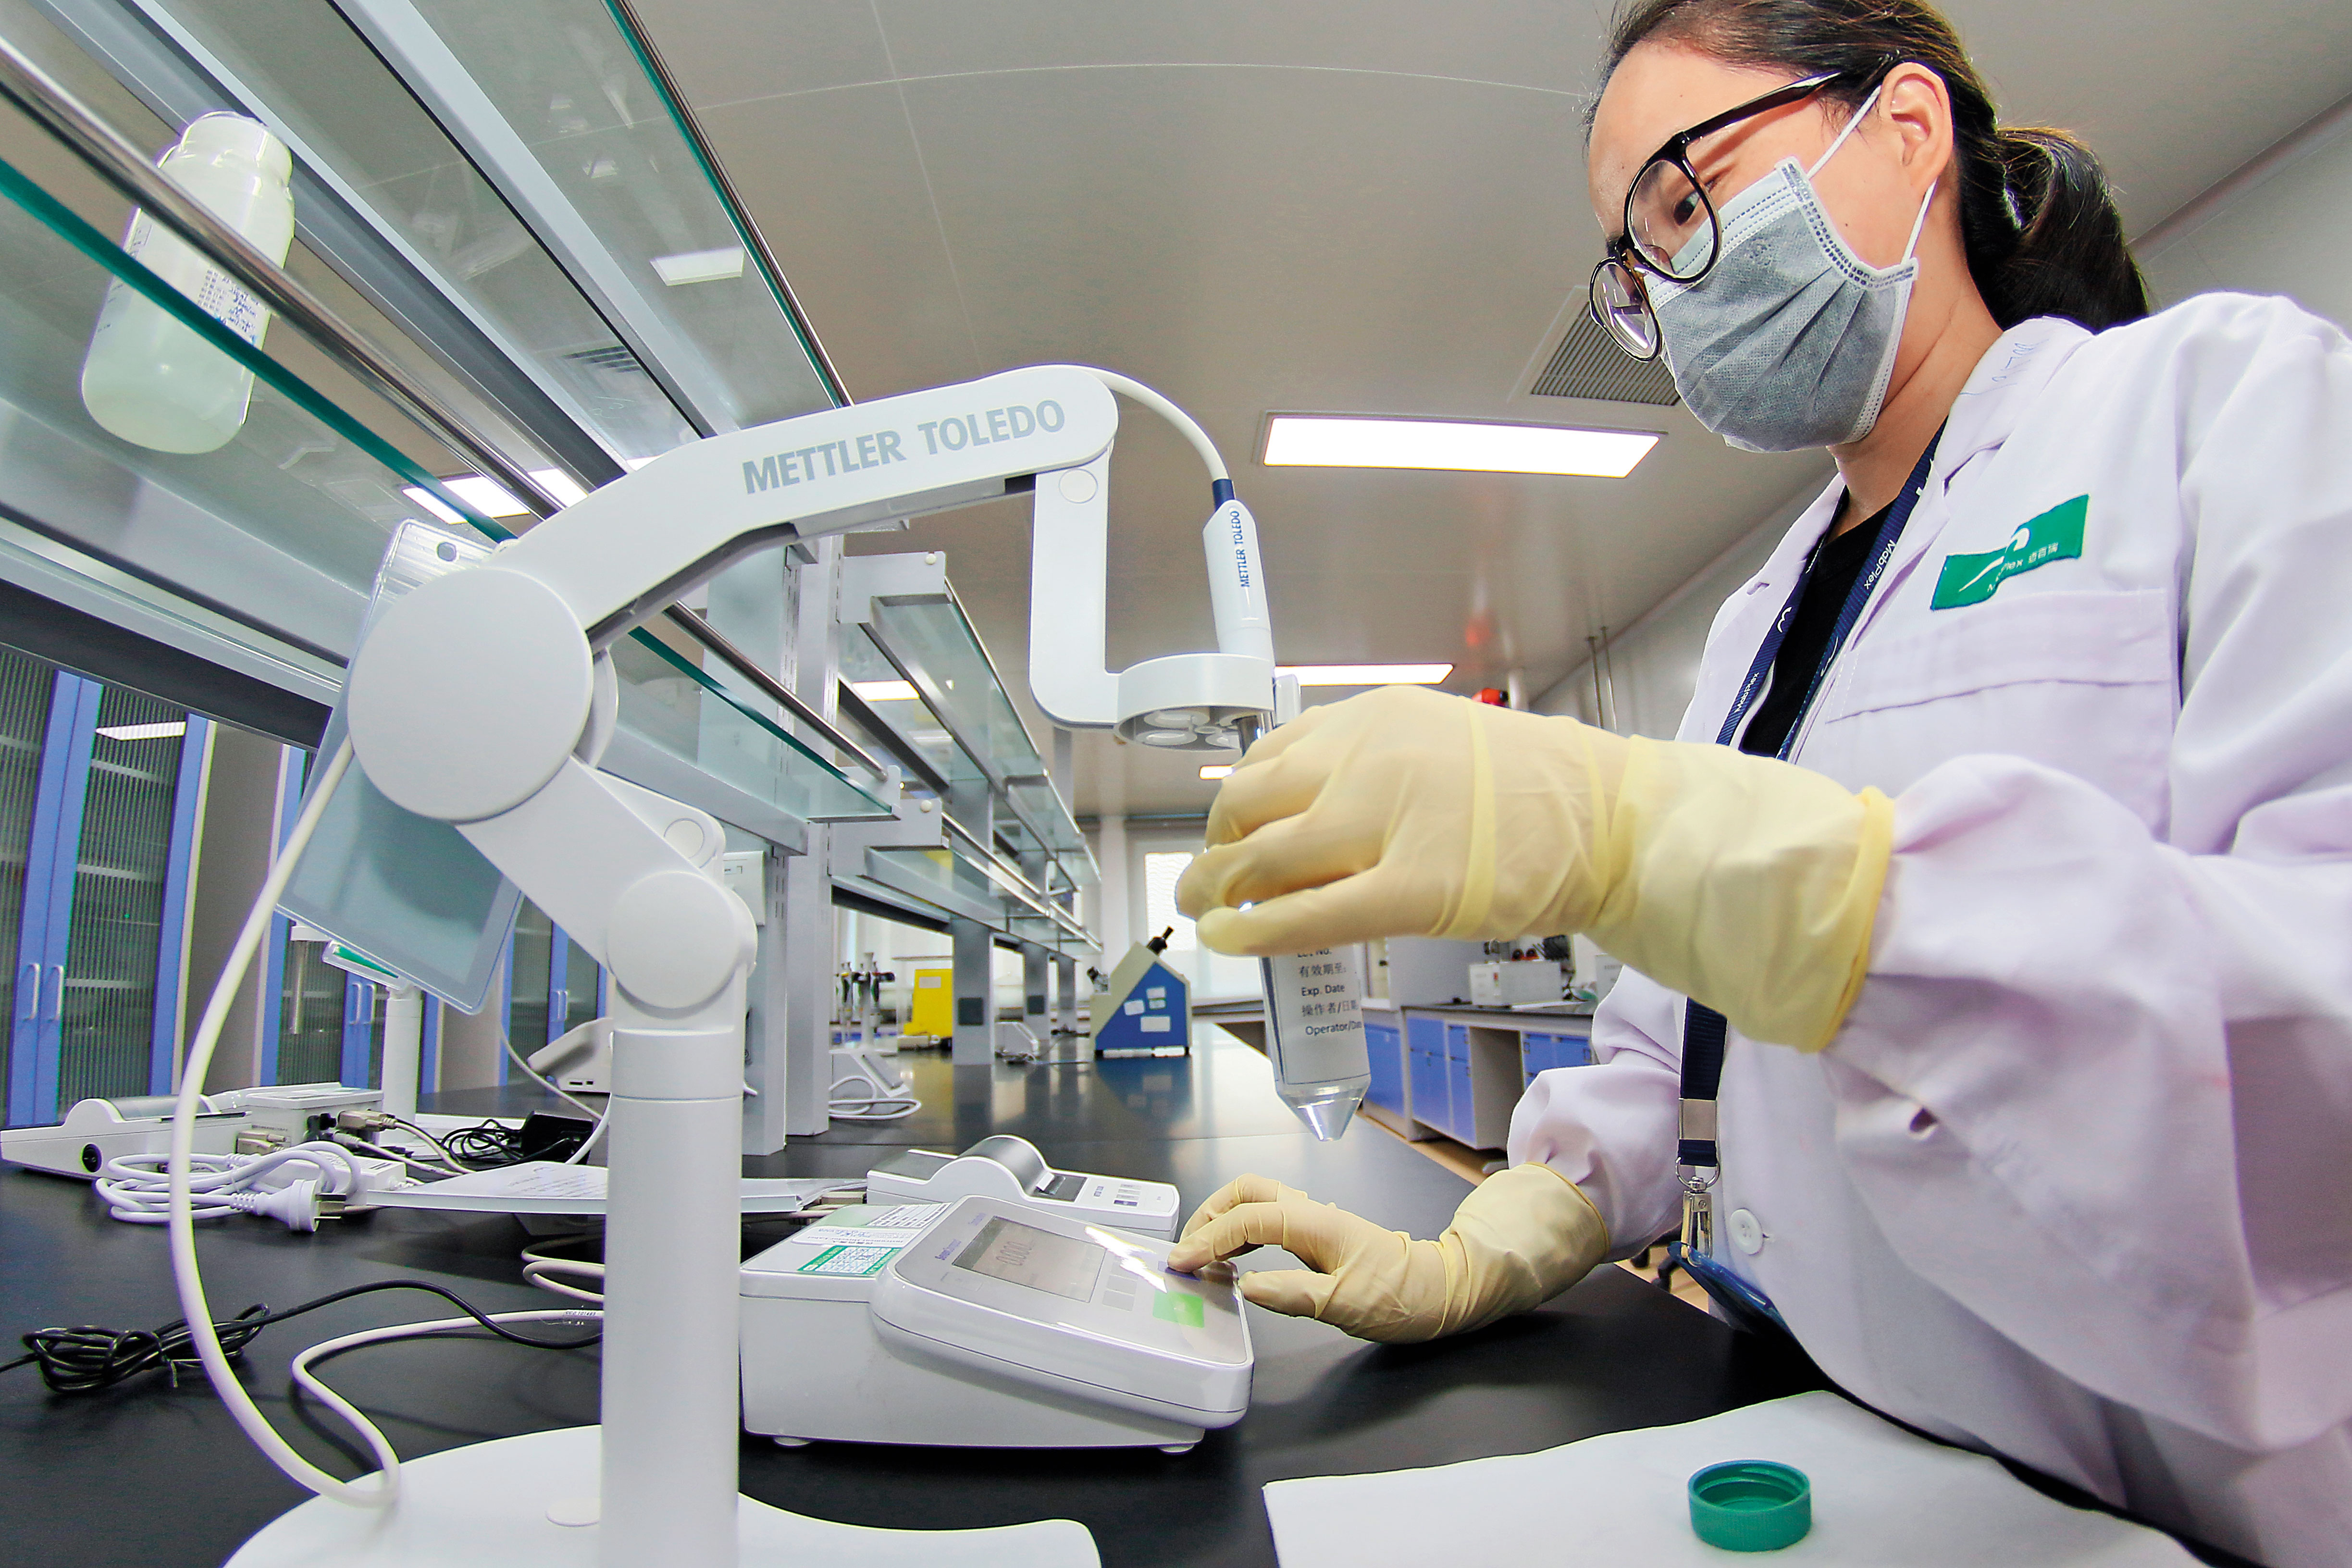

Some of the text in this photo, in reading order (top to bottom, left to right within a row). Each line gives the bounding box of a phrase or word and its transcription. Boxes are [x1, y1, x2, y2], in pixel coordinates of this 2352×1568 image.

[742, 399, 1065, 495] METTLER TOLEDO
[1230, 510, 1250, 587] METTLER TOLEDO
[1864, 539, 1896, 590] MabPlex
[1734, 672, 1759, 713] MabPlex
[1325, 984, 1345, 994] Date
